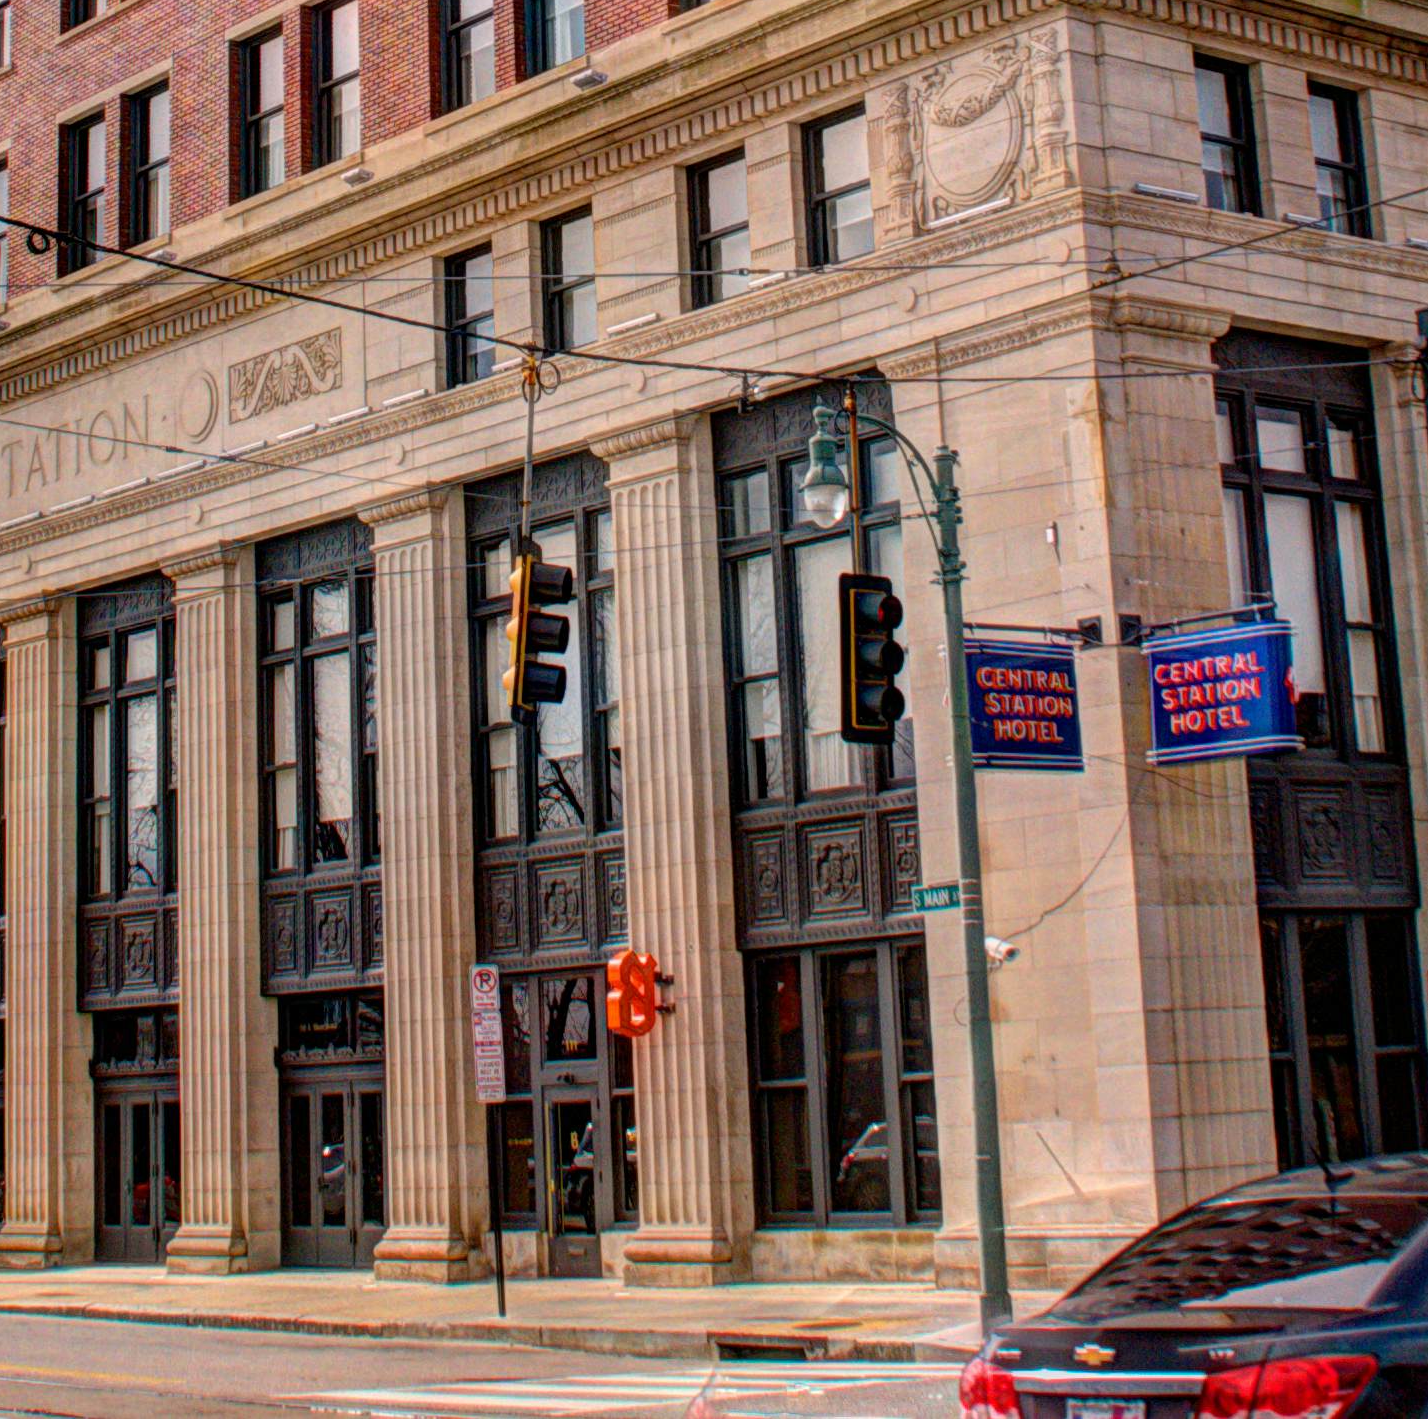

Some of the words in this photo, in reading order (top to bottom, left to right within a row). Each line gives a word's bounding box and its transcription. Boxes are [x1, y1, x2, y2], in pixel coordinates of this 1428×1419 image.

[976, 666, 1075, 694] CENTRAL
[1155, 651, 1266, 685] CENTRAL
[984, 692, 1073, 719] STATION
[1161, 677, 1262, 711] STATION
[993, 719, 1064, 743] HOTEL
[1170, 705, 1251, 736] HOTEL
[914, 892, 922, 908] S
[923, 888, 950, 908] MAIN
